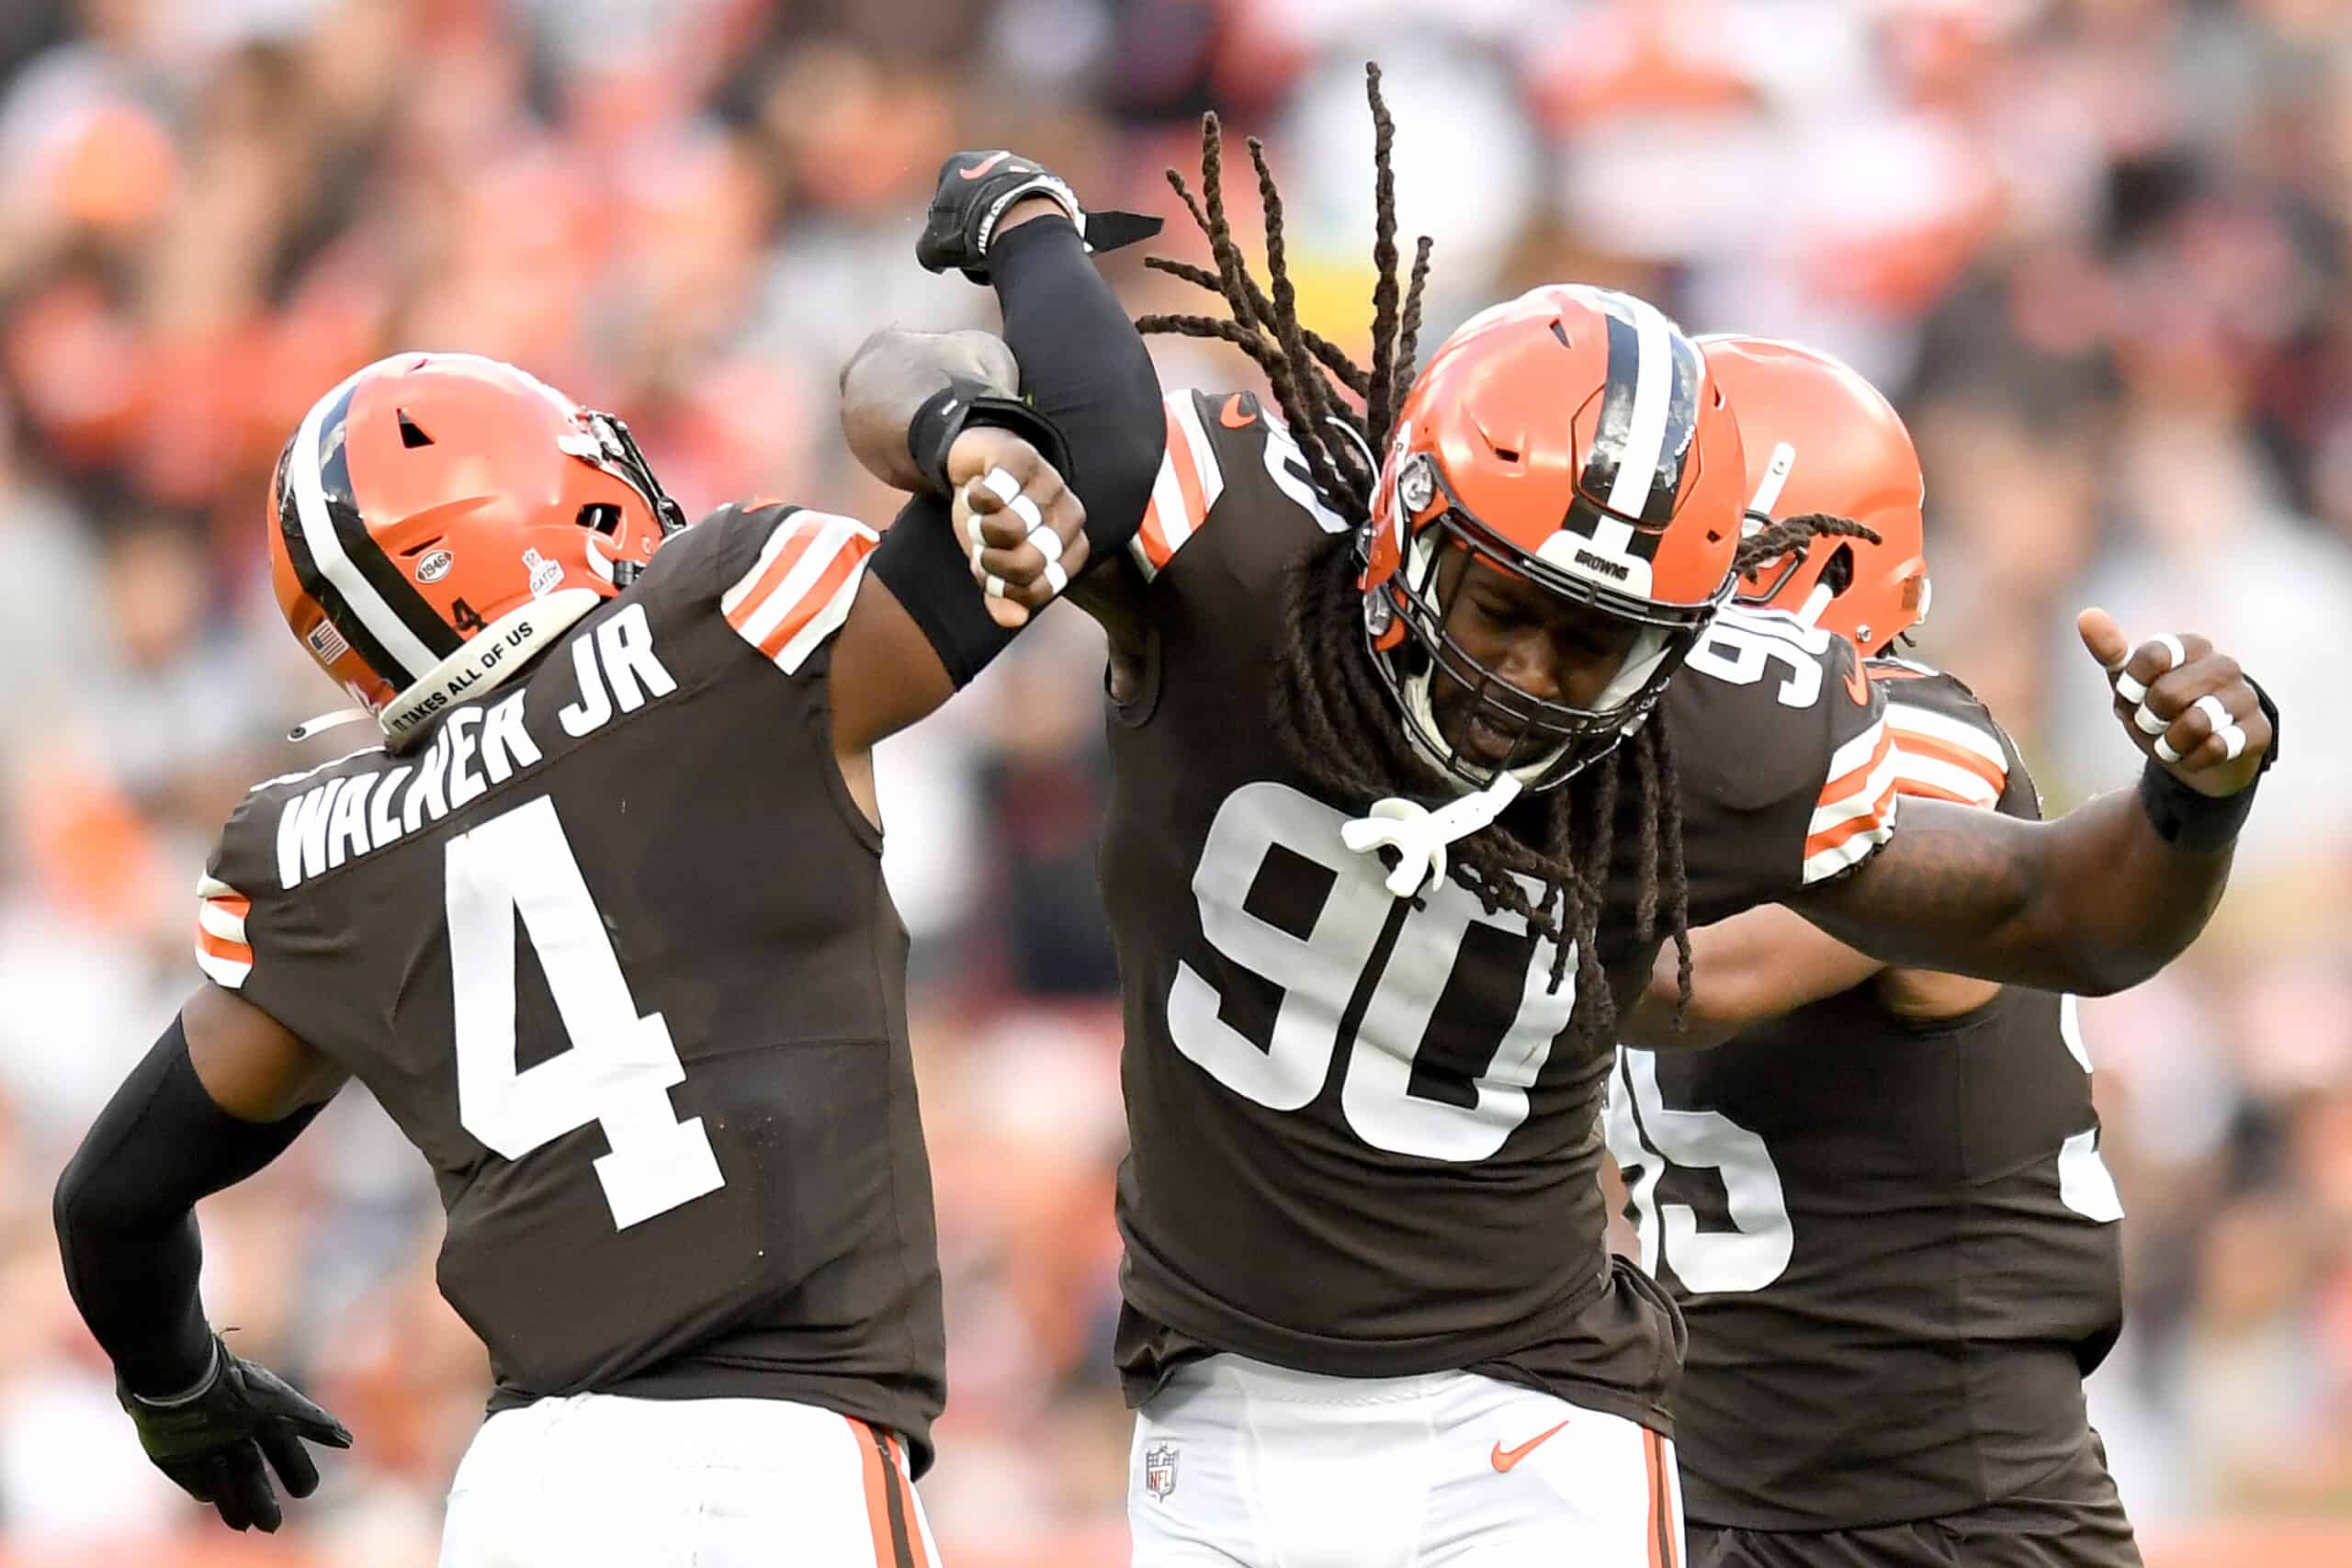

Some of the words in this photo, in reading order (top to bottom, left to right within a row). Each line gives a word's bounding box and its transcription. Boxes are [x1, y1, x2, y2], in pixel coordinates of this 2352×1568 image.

[423, 554, 447, 577] 1946
[1574, 548, 1629, 581] BROWNS
[401, 692, 448, 726] TAKES
[447, 668, 483, 697] ALL
[481, 643, 504, 669] OF
[505, 621, 533, 647] US
[559, 603, 679, 738] JR
[445, 794, 727, 1232] 4
[1167, 781, 1577, 1162] 90
